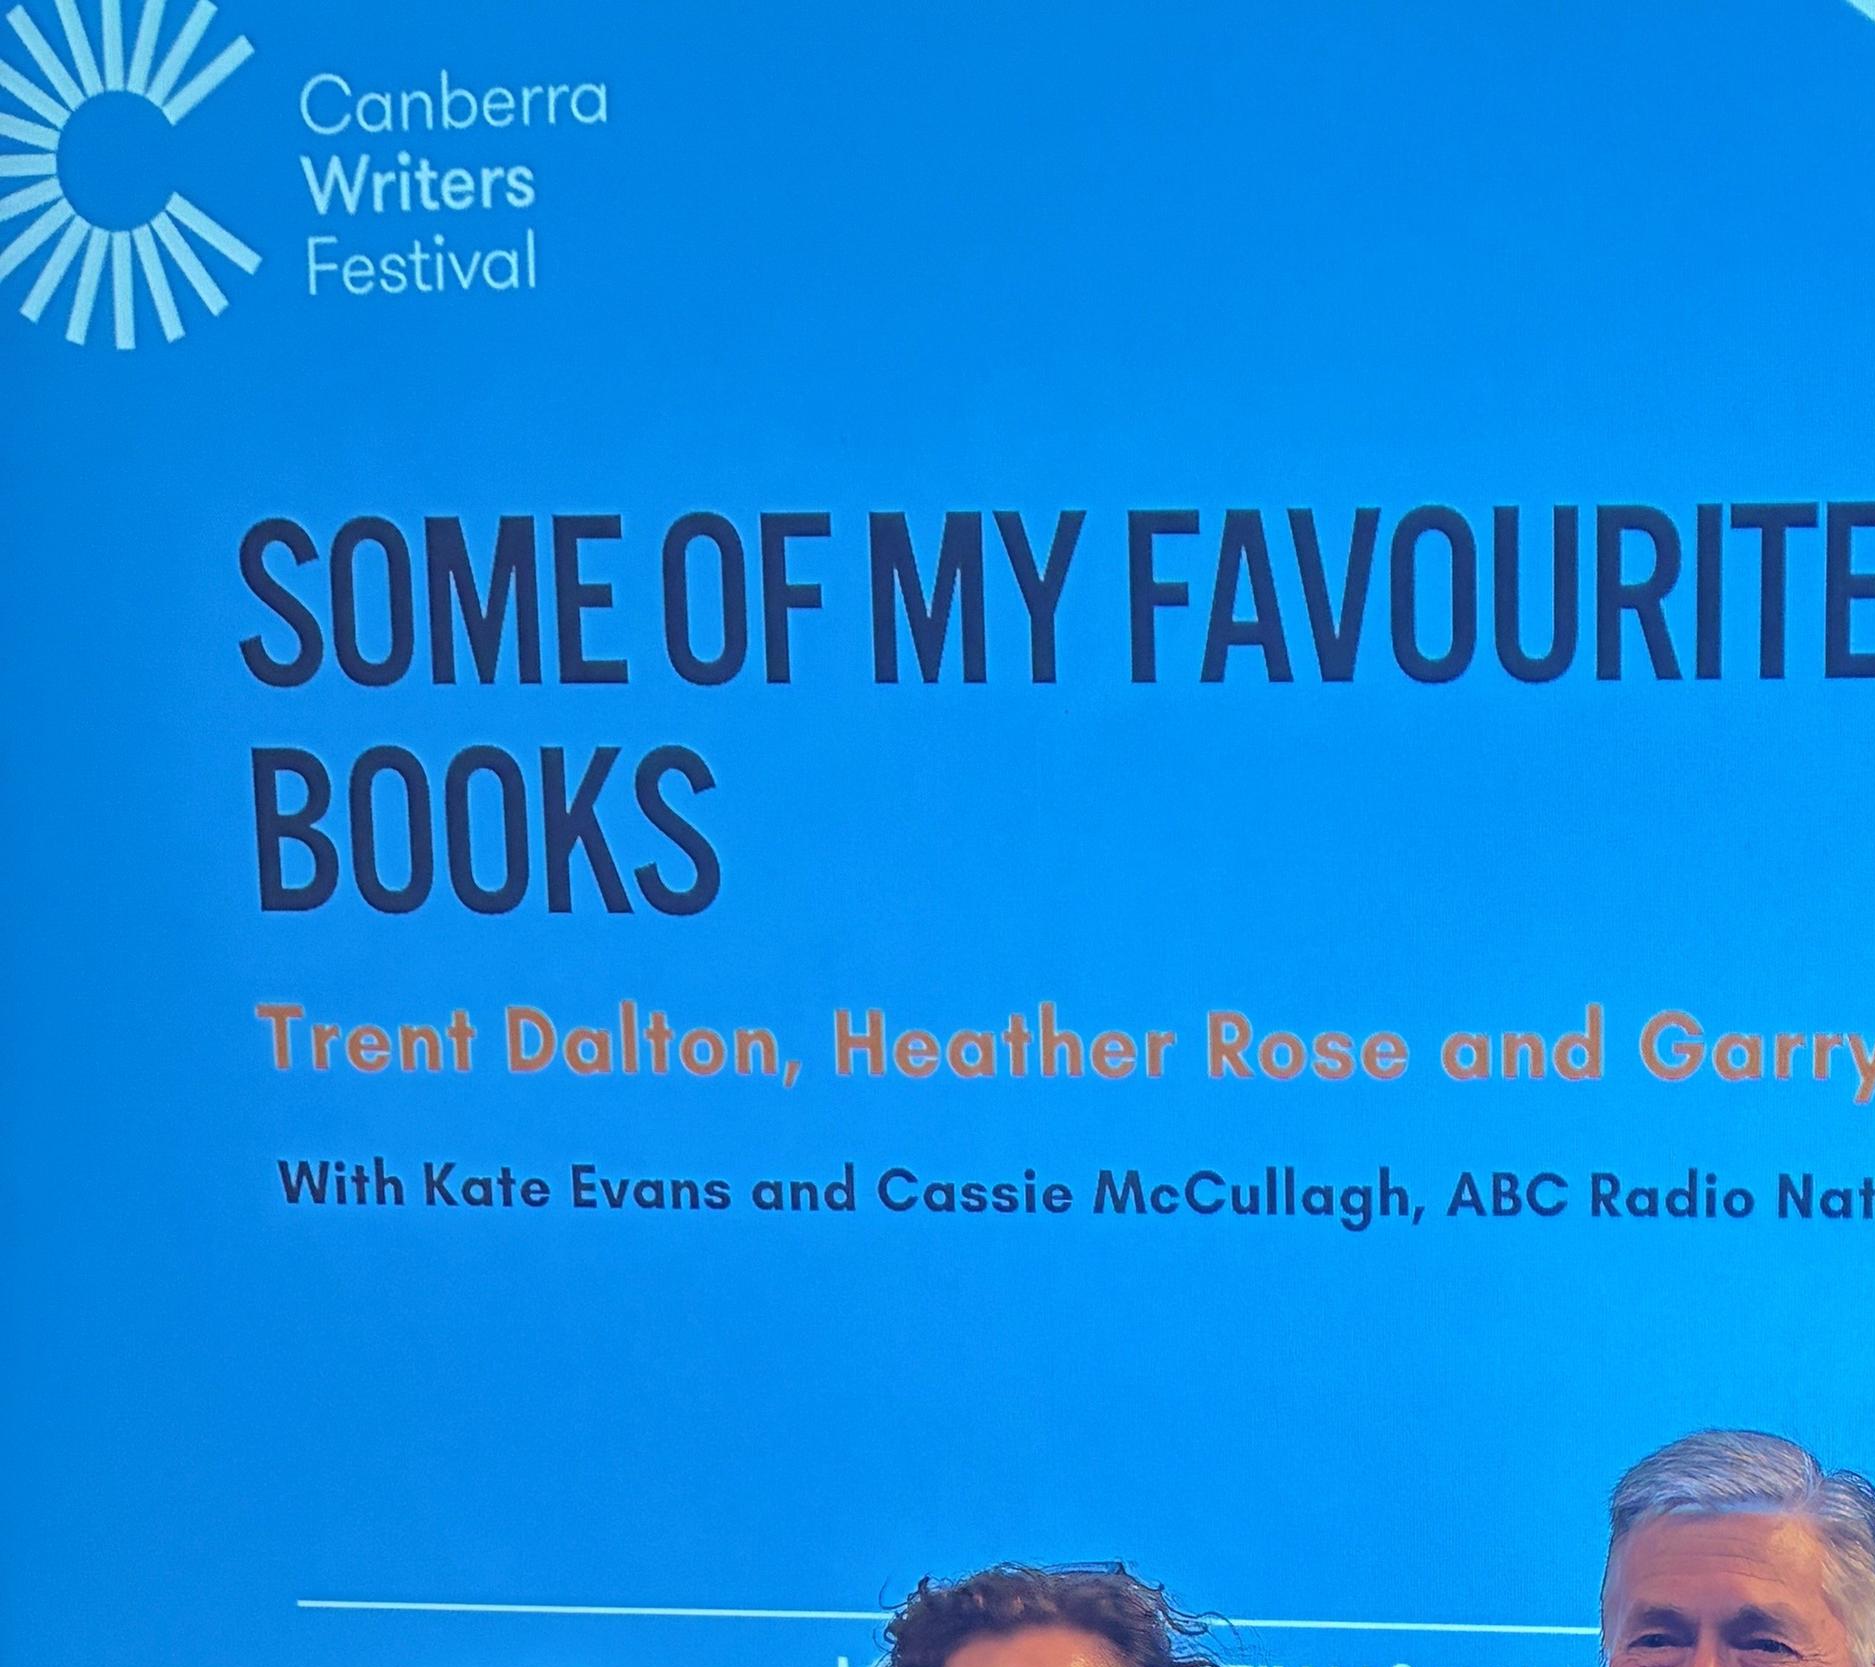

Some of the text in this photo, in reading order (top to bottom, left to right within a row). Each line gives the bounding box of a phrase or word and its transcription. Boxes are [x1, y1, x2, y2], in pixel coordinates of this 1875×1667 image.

[299, 69, 608, 135] Canberra
[299, 150, 536, 216] Writers
[306, 228, 538, 295] Festival
[238, 513, 629, 688] SOME
[662, 510, 832, 687] OF
[868, 508, 1088, 684] MY
[250, 744, 722, 916] BOOKS
[254, 1002, 478, 1072] Trent
[504, 999, 802, 1089] Dalton,
[834, 1000, 1176, 1081] Heather
[1206, 1009, 1410, 1082] Rose
[1440, 1003, 1604, 1082] and
[277, 1156, 405, 1206] With
[423, 1161, 552, 1208] Kate
[570, 1163, 733, 1212] Evans
[751, 1162, 857, 1213] and
[877, 1166, 1073, 1214] Cassie
[1092, 1165, 1424, 1233] McCullagh,
[1445, 1170, 1569, 1218] ABC
[1590, 1167, 1754, 1219] Radio
